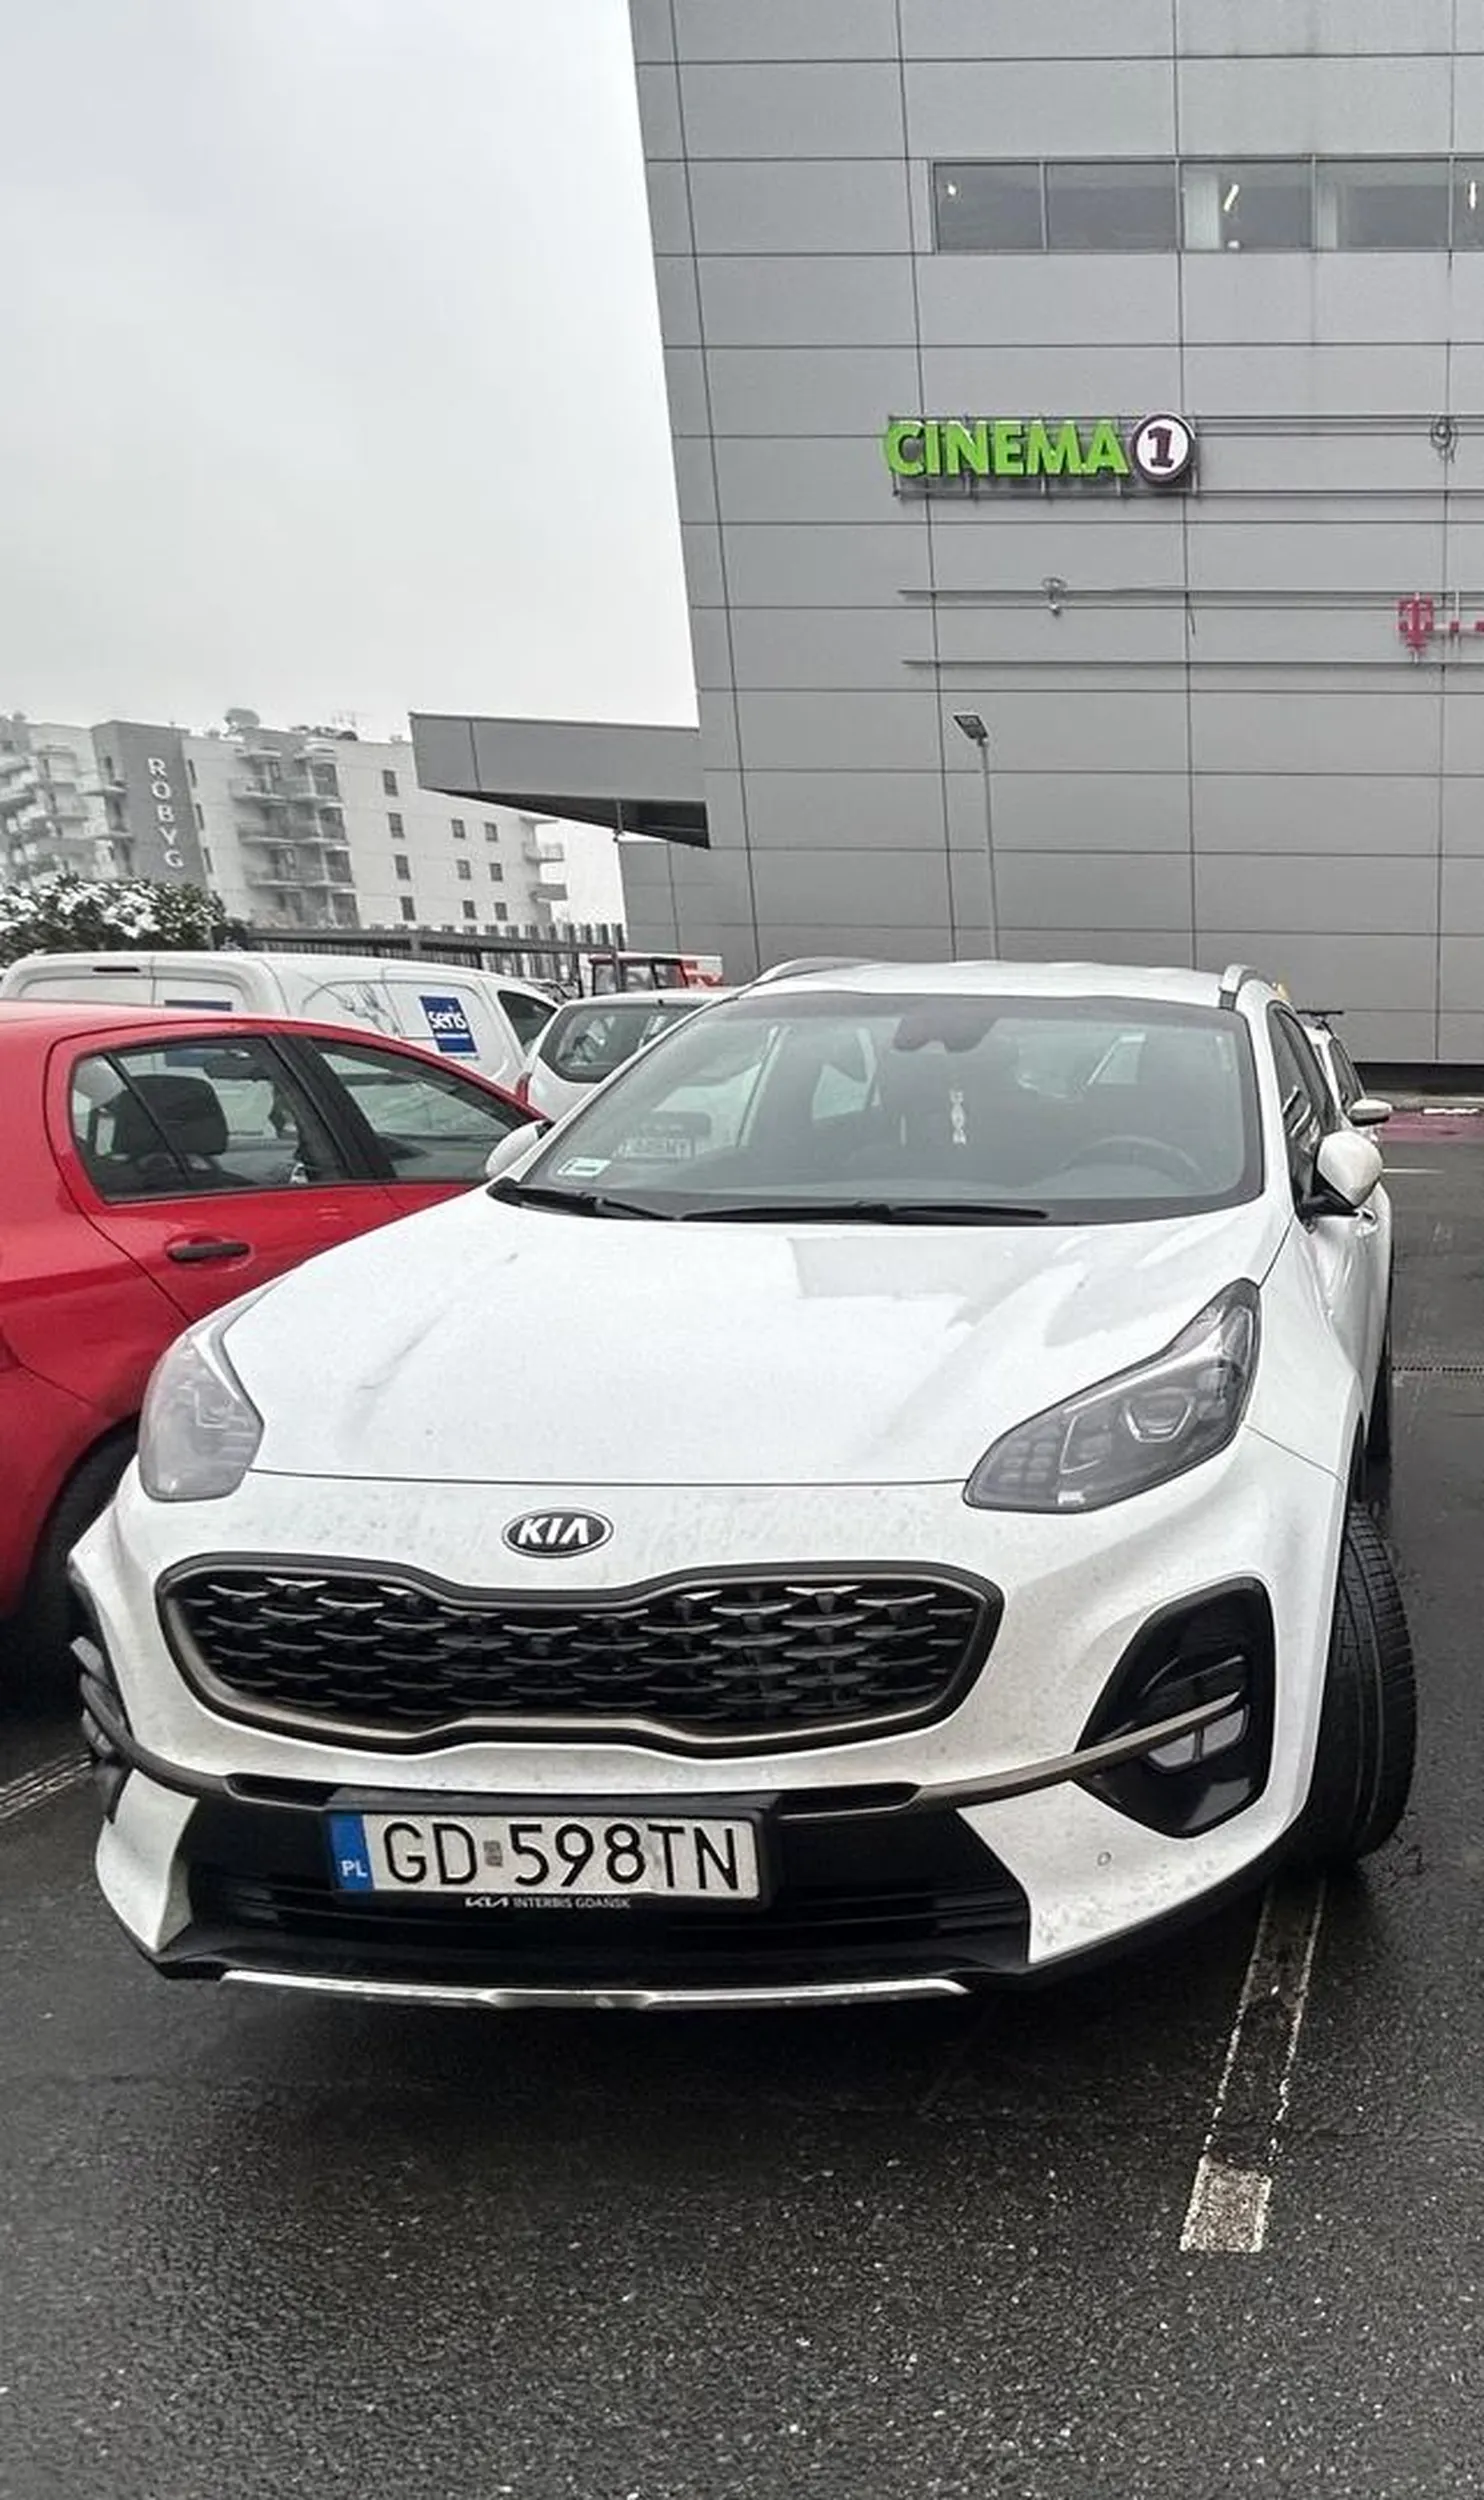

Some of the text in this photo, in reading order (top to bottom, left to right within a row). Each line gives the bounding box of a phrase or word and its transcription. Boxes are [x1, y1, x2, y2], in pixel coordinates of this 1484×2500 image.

[885, 418, 1130, 477] CINEMA
[148, 757, 184, 868] ROBYG
[517, 1517, 589, 1545] KIA
[341, 1858, 368, 1878] PL
[383, 1822, 740, 1891] GD 598TN
